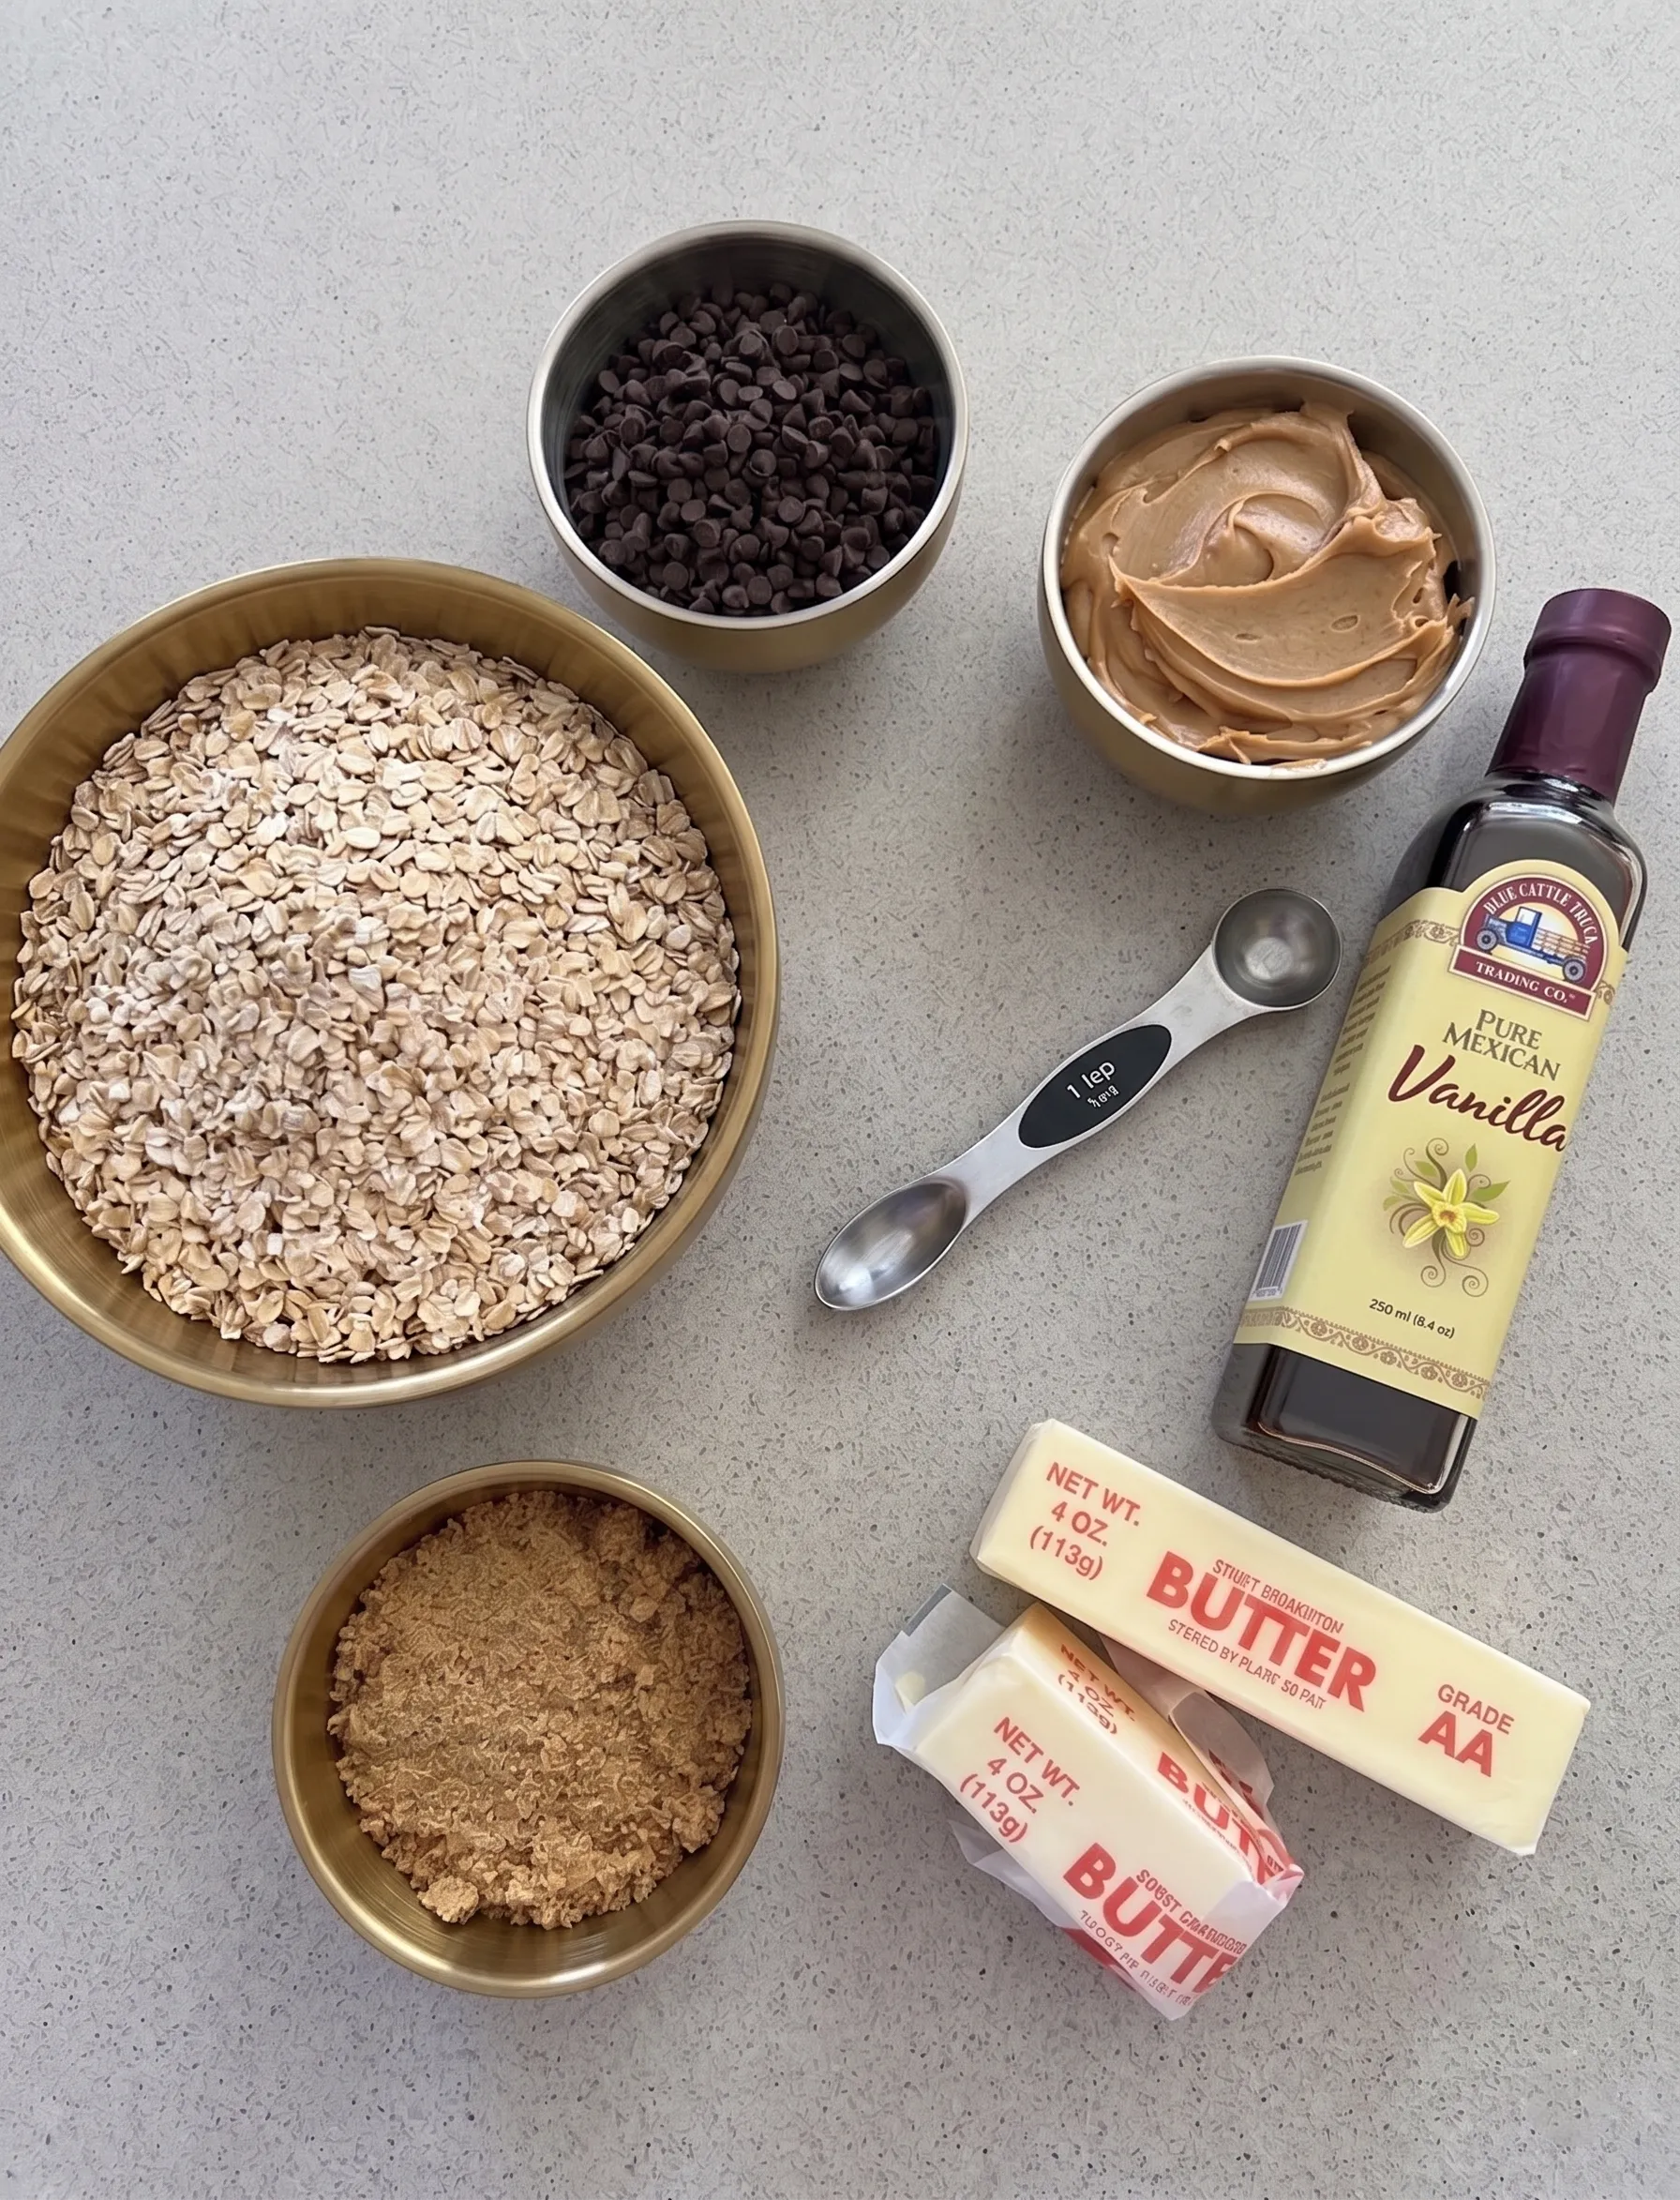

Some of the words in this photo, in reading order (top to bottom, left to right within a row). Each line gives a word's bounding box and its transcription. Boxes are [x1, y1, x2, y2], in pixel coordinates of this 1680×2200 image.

[1519, 882, 1572, 908] CATTLE
[1476, 961, 1540, 991] TRADING
[1442, 1021, 1561, 1081] MEXICAN
[1476, 1009, 1543, 1050] PURE
[1067, 1084, 1081, 1099] 1
[1388, 1044, 1567, 1152] Vanilla
[1369, 1298, 1393, 1316] 250
[1394, 1310, 1412, 1322] ml
[1413, 1314, 1435, 1331] (8.4
[1436, 1326, 1455, 1339] oz)
[1045, 1461, 1099, 1500] NET
[1102, 1487, 1141, 1527] WT.
[1051, 1500, 1069, 1522] 4
[1071, 1511, 1108, 1546] OZ.
[1029, 1525, 1103, 1580] (113g)
[1146, 1550, 1376, 1712] BUTTER
[1167, 1619, 1219, 1653] STERED
[1219, 1647, 1240, 1665] BY
[1060, 1643, 1099, 1683] NET
[1068, 1669, 1081, 1681] 4
[1437, 1683, 1515, 1735] GRADE
[993, 1716, 1043, 1764] NET
[1042, 1759, 1080, 1807] WT.
[1418, 1710, 1492, 1777] AA
[986, 1757, 1007, 1777] 4
[960, 1773, 1028, 1843] (113g)
